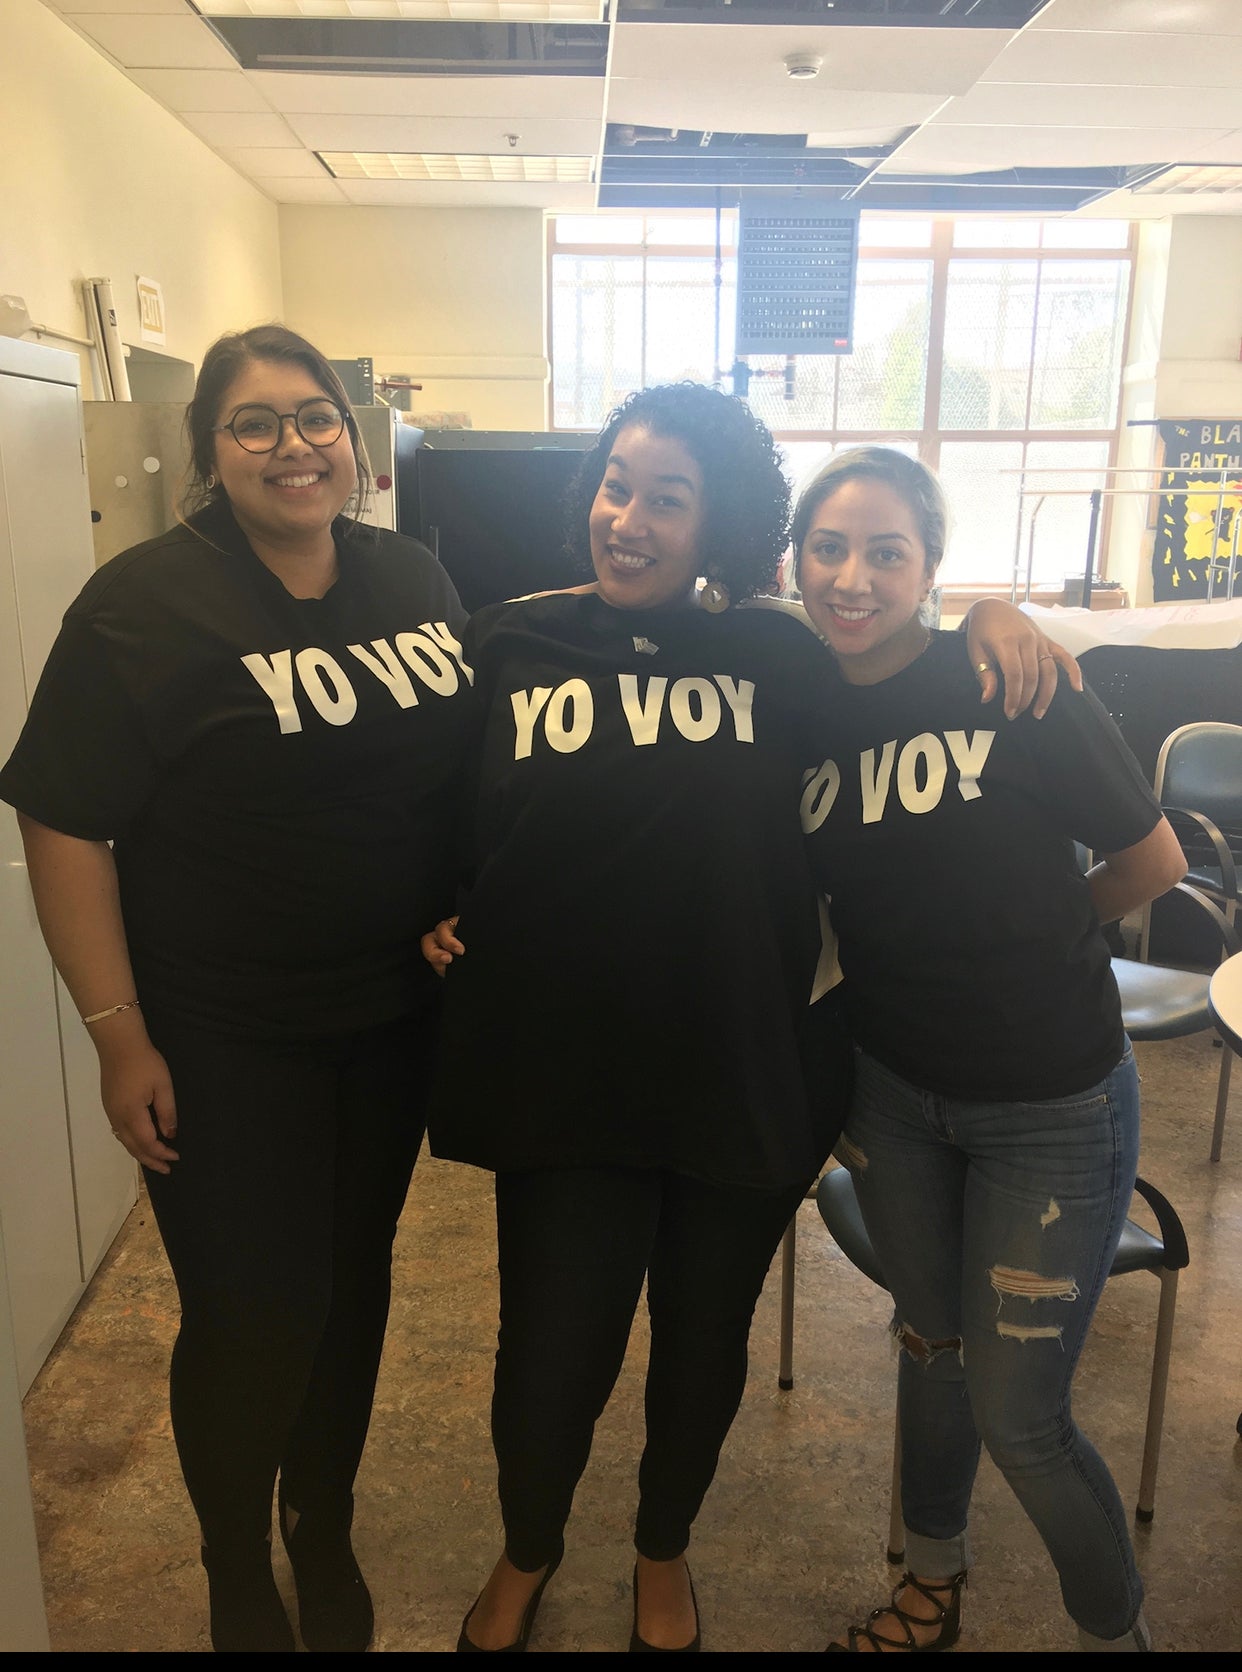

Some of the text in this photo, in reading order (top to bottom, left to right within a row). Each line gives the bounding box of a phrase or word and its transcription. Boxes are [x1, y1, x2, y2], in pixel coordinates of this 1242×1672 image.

[1174, 424, 1241, 445] THE BLA
[239, 621, 475, 735] YO VOY
[510, 673, 756, 761] YO VOY
[799, 729, 997, 834] O VOY
